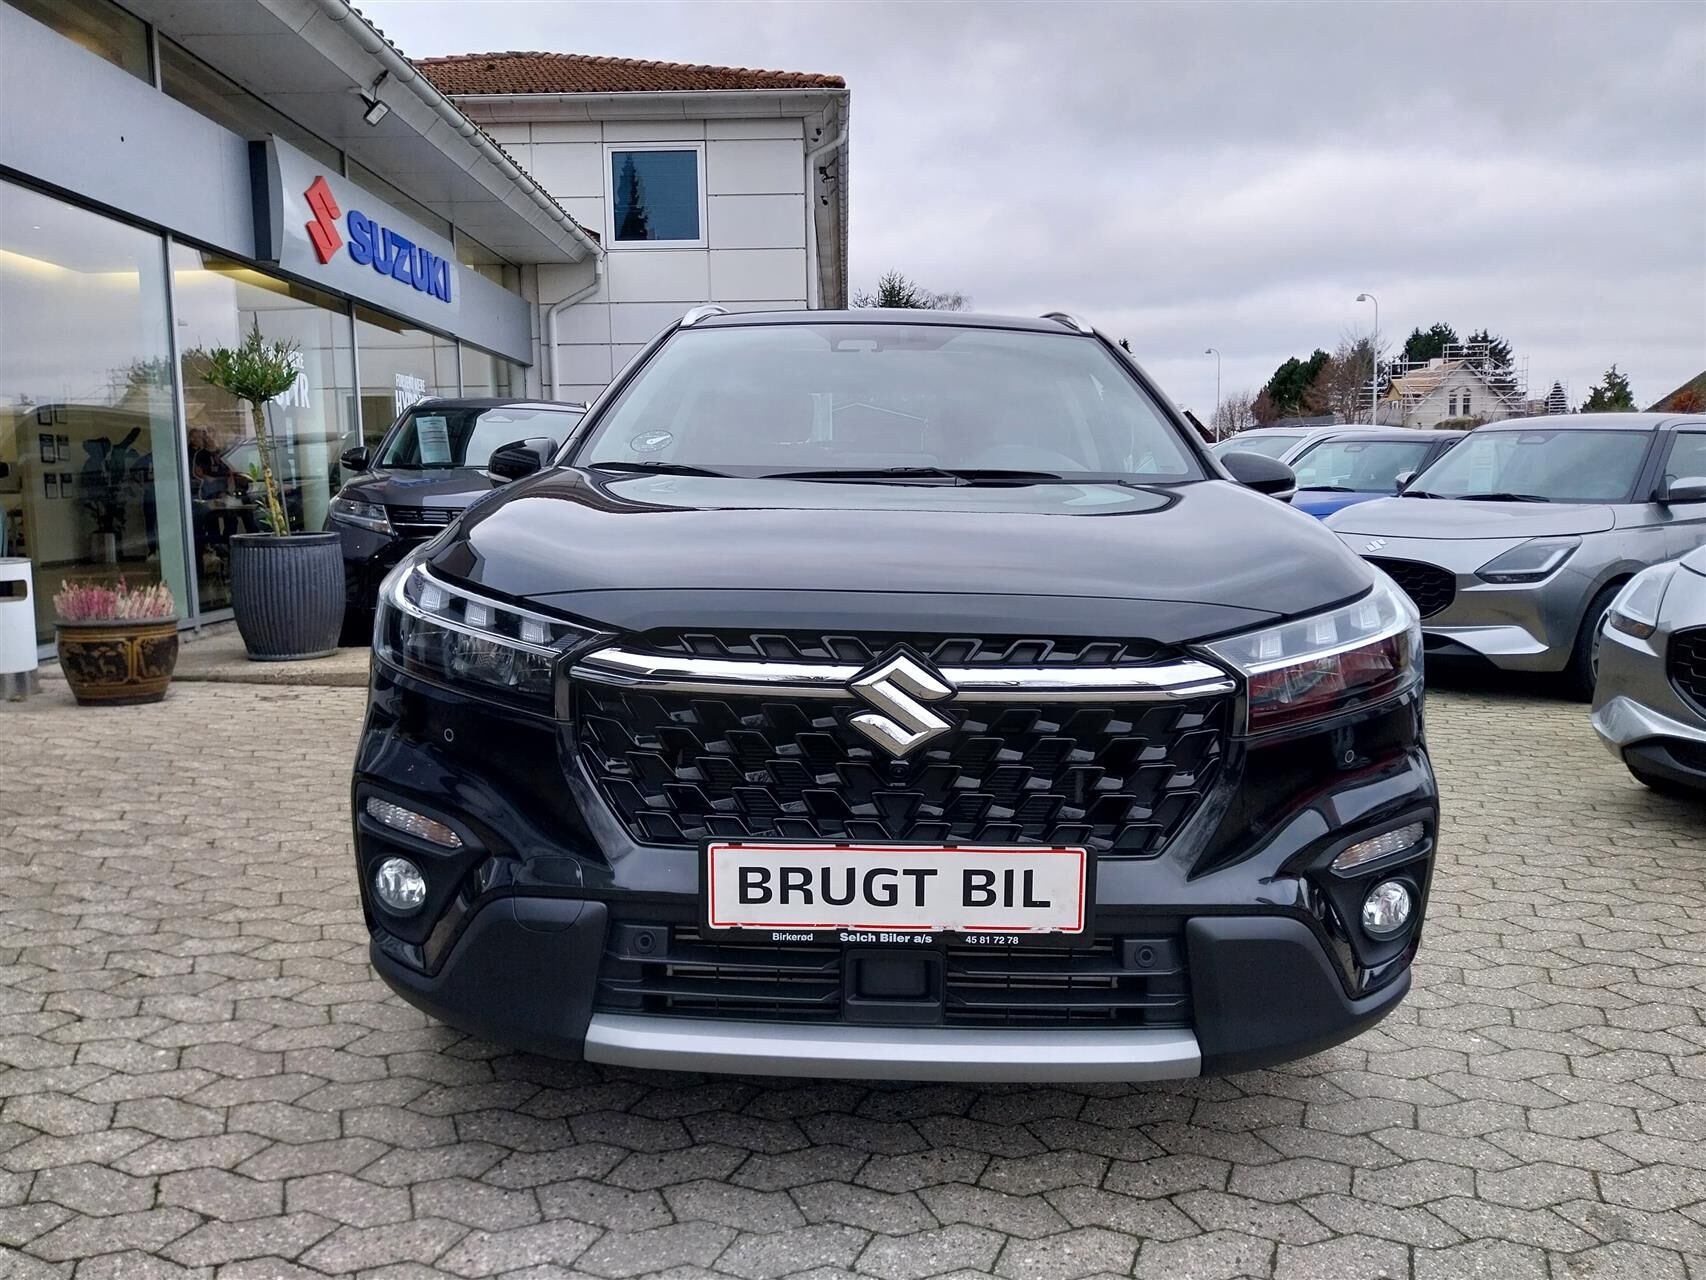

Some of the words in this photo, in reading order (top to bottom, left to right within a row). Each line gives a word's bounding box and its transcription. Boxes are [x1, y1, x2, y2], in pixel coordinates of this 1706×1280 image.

[347, 210, 451, 303] SUZUKI
[738, 865, 938, 906] BRUGT
[961, 868, 1051, 908] BIL
[772, 932, 814, 942] Birkerød
[839, 932, 876, 942] Selch
[879, 933, 910, 943] Biler
[913, 934, 933, 944] a/s
[965, 935, 977, 944] 45
[979, 935, 990, 944] 81
[993, 936, 1005, 945] 72
[1007, 936, 1019, 945] 78
